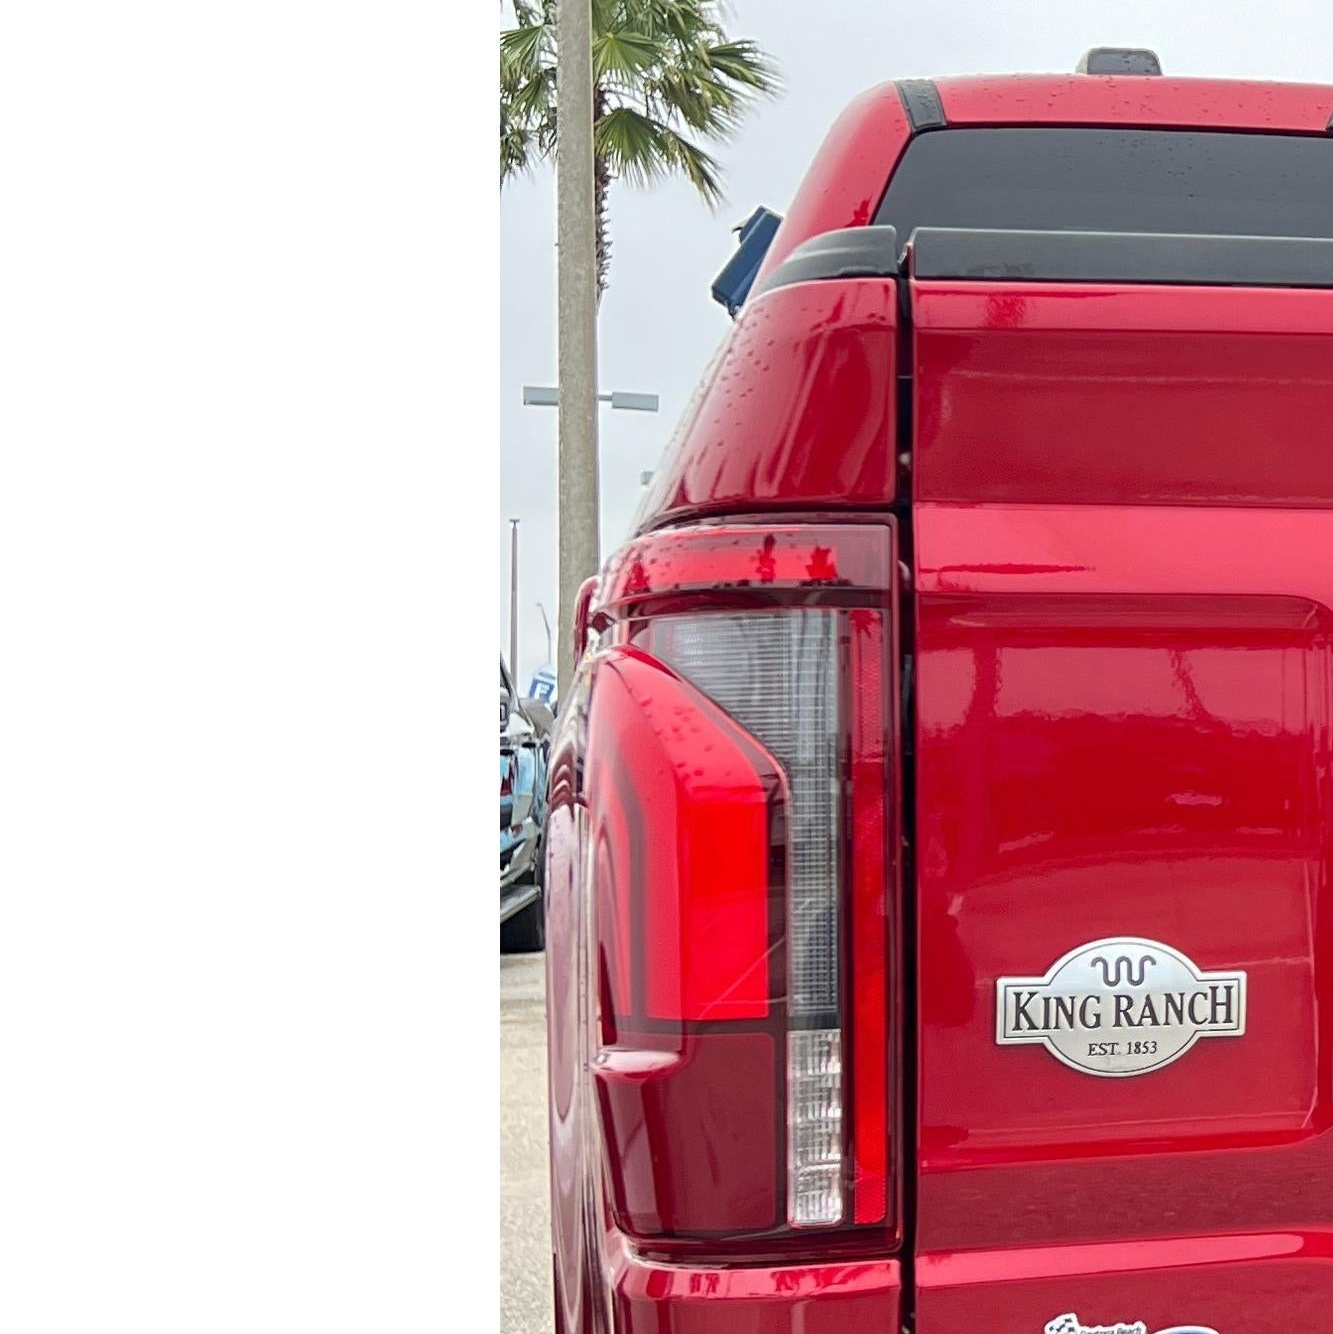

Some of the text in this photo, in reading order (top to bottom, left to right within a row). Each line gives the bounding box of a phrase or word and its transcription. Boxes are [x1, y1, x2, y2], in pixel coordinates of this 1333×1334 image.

[1012, 985, 1234, 1031] KING RANCH
[1127, 1041, 1158, 1055] 1853
